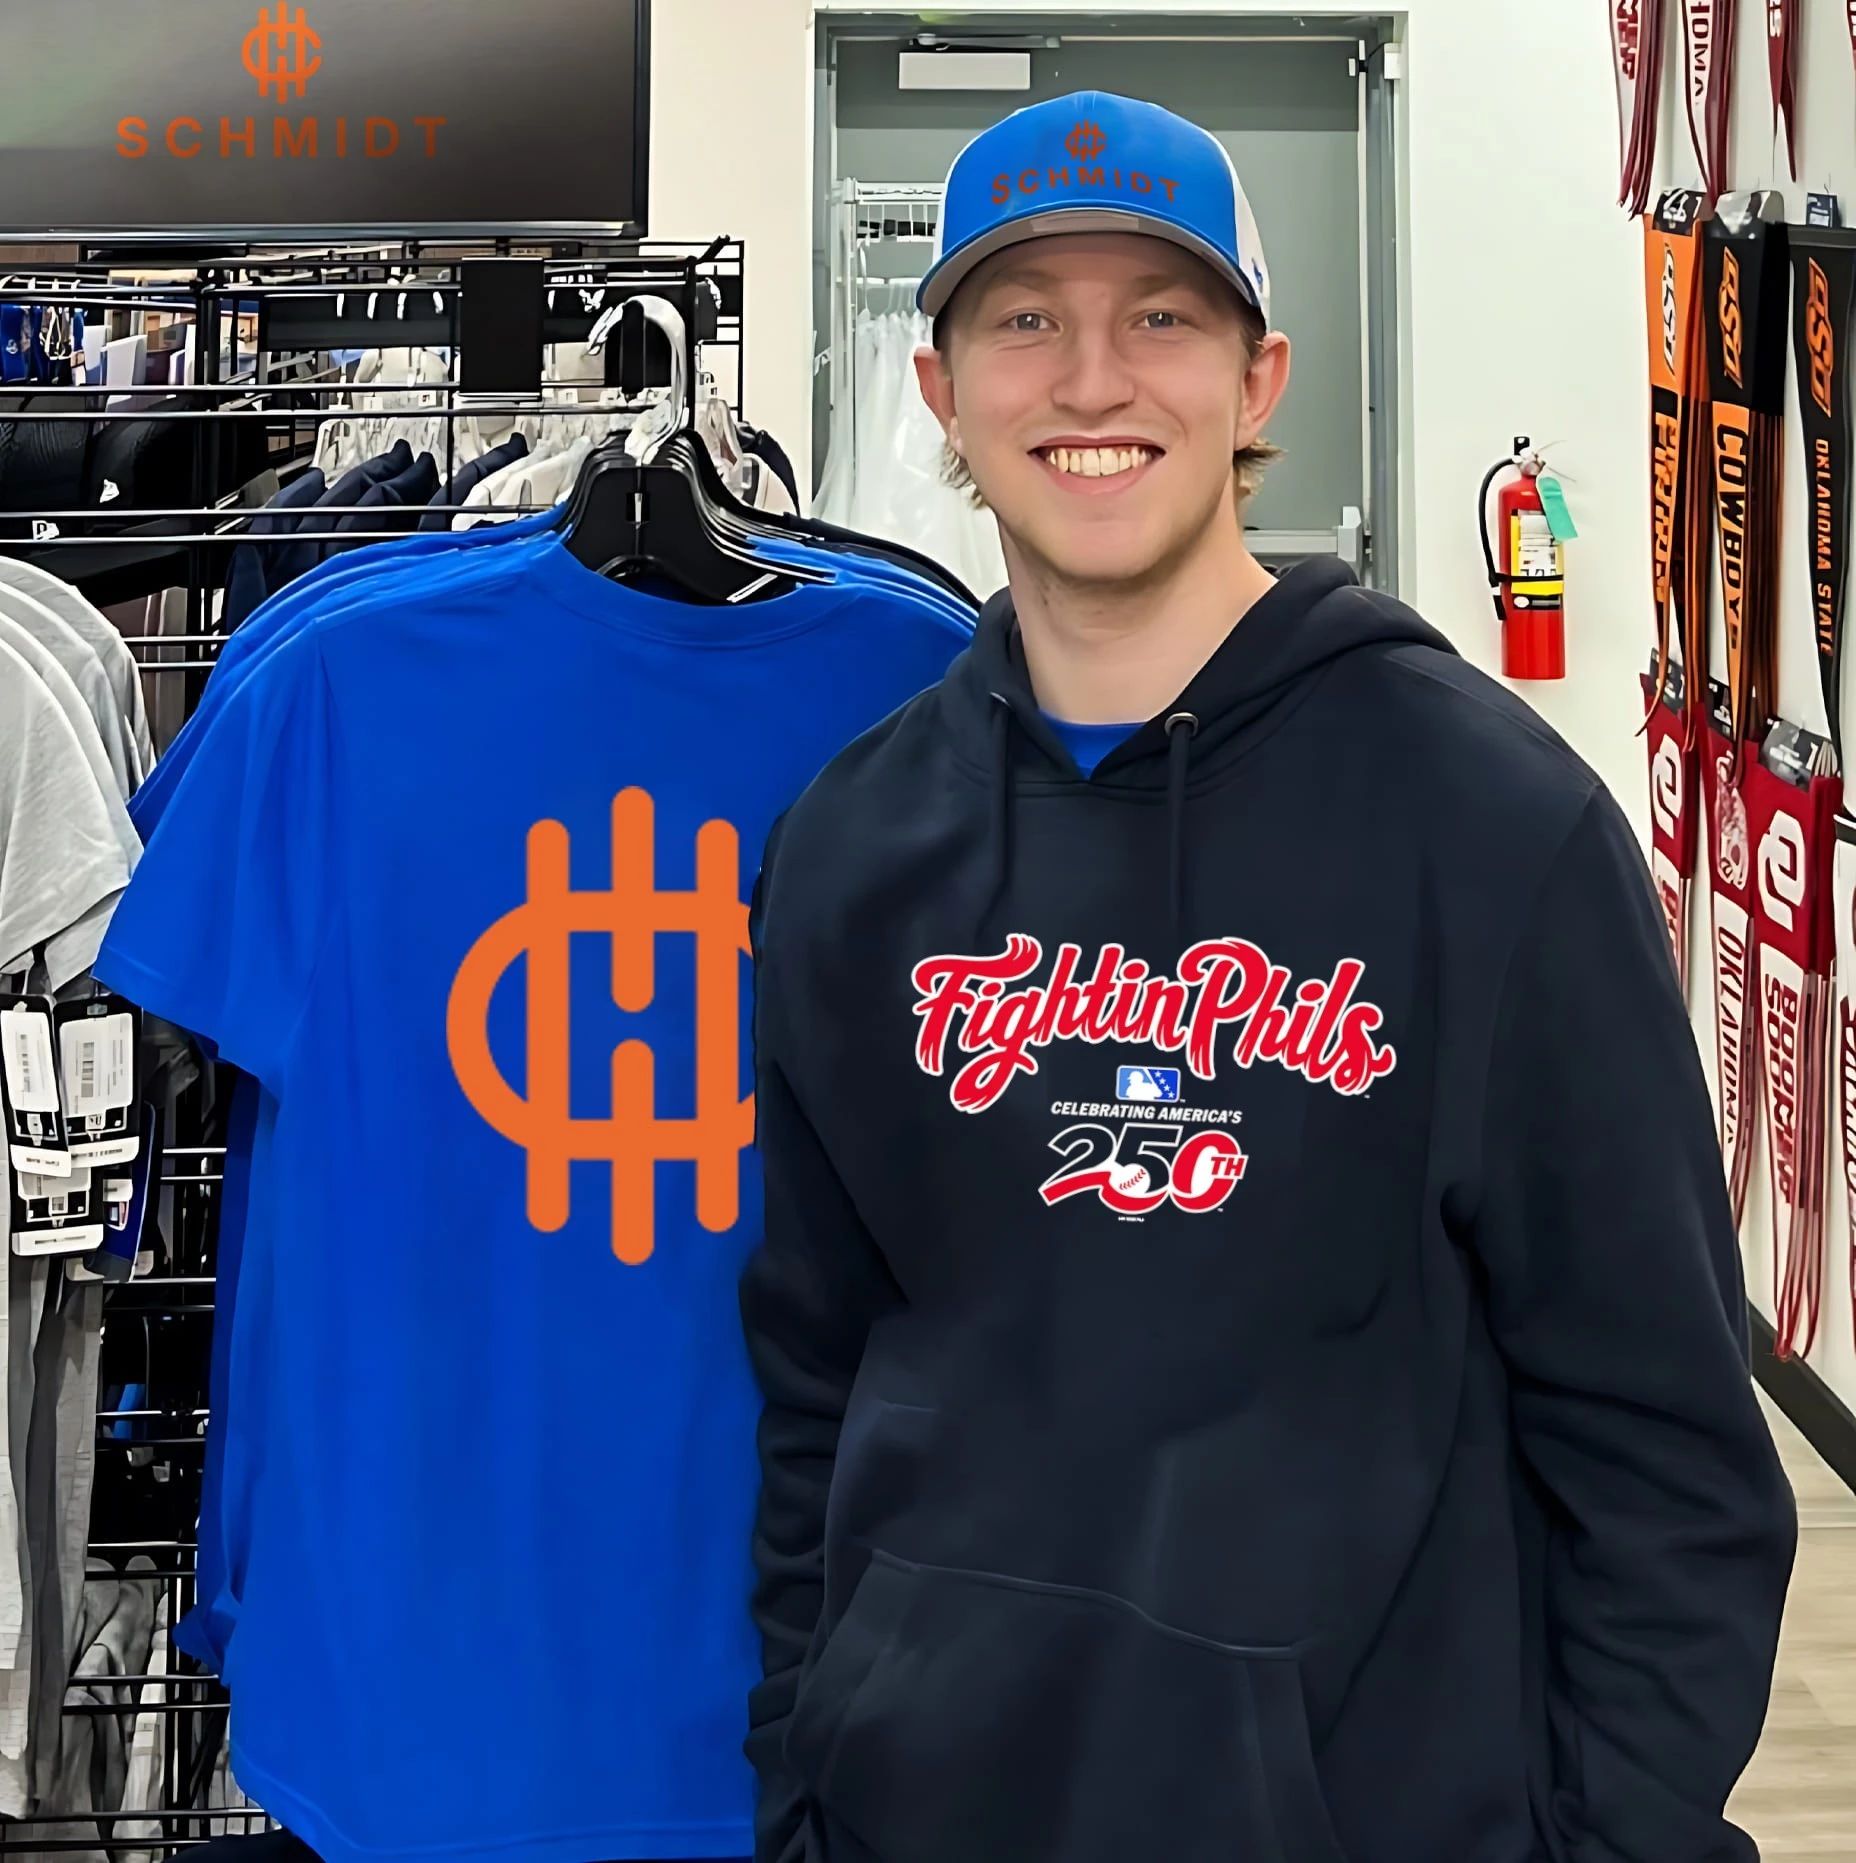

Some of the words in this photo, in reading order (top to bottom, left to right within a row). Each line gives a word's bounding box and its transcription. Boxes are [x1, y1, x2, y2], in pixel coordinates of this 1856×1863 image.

[115, 115, 448, 159] SCHMIDT
[992, 166, 1181, 205] SCHMIDT
[1716, 422, 1749, 650] COWBOY
[1815, 438, 1832, 570] OKLAHOMA
[1816, 583, 1834, 656] STATE
[911, 932, 1191, 1114] Fightin
[1177, 936, 1397, 1096] Phils
[1718, 926, 1745, 1144] OKLAHOMA
[1050, 1100, 1155, 1121] CELEBRATING
[1157, 1105, 1243, 1124] AMERICA'S
